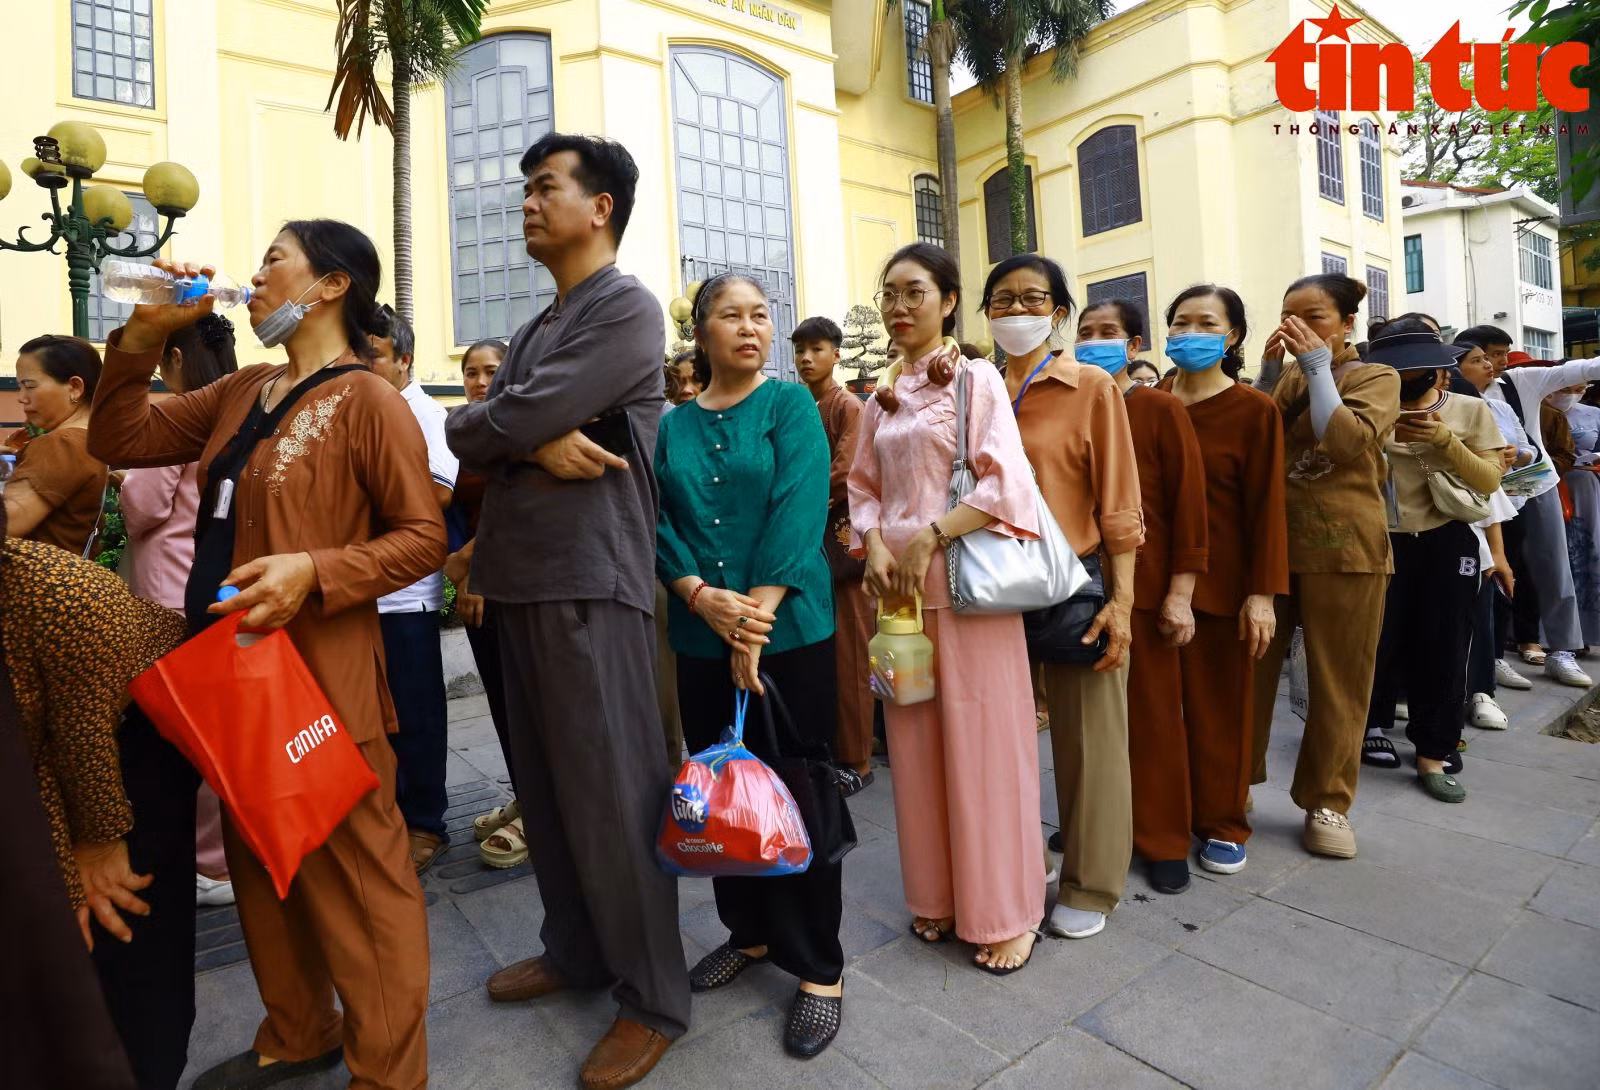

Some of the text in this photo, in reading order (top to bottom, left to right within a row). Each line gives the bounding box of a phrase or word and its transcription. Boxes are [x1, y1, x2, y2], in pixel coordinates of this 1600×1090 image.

[777, 12, 796, 30] DÂN
[1459, 556, 1477, 576] B
[285, 714, 337, 764] CANIFA
